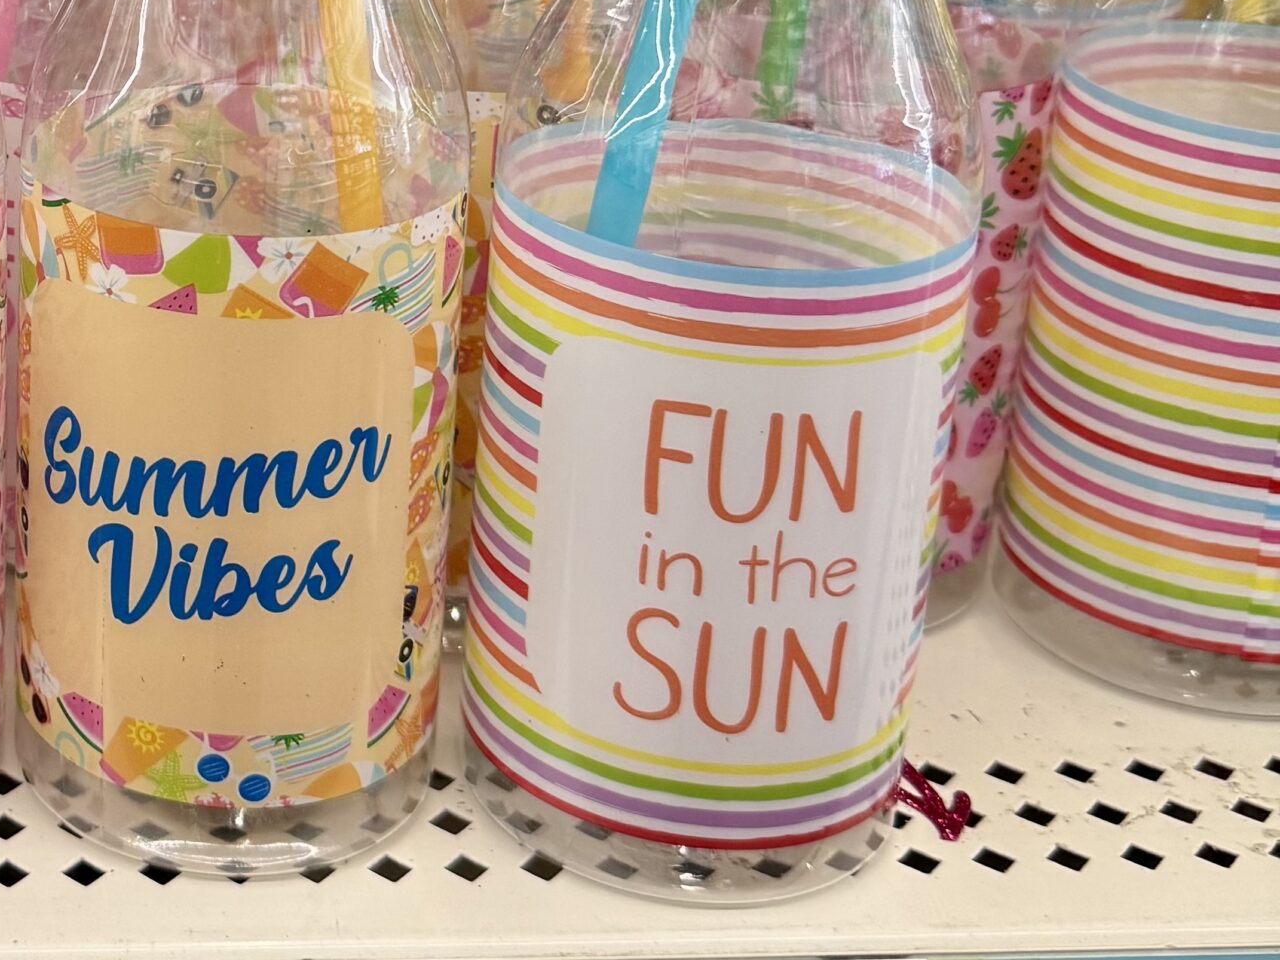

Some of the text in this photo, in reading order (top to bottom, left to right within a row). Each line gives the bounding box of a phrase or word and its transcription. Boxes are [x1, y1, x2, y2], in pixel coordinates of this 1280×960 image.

[43, 405, 392, 518] Summer
[644, 400, 862, 523] FUN
[87, 523, 354, 624] Vibes
[638, 530, 858, 604] in the
[613, 608, 848, 734] SUN
